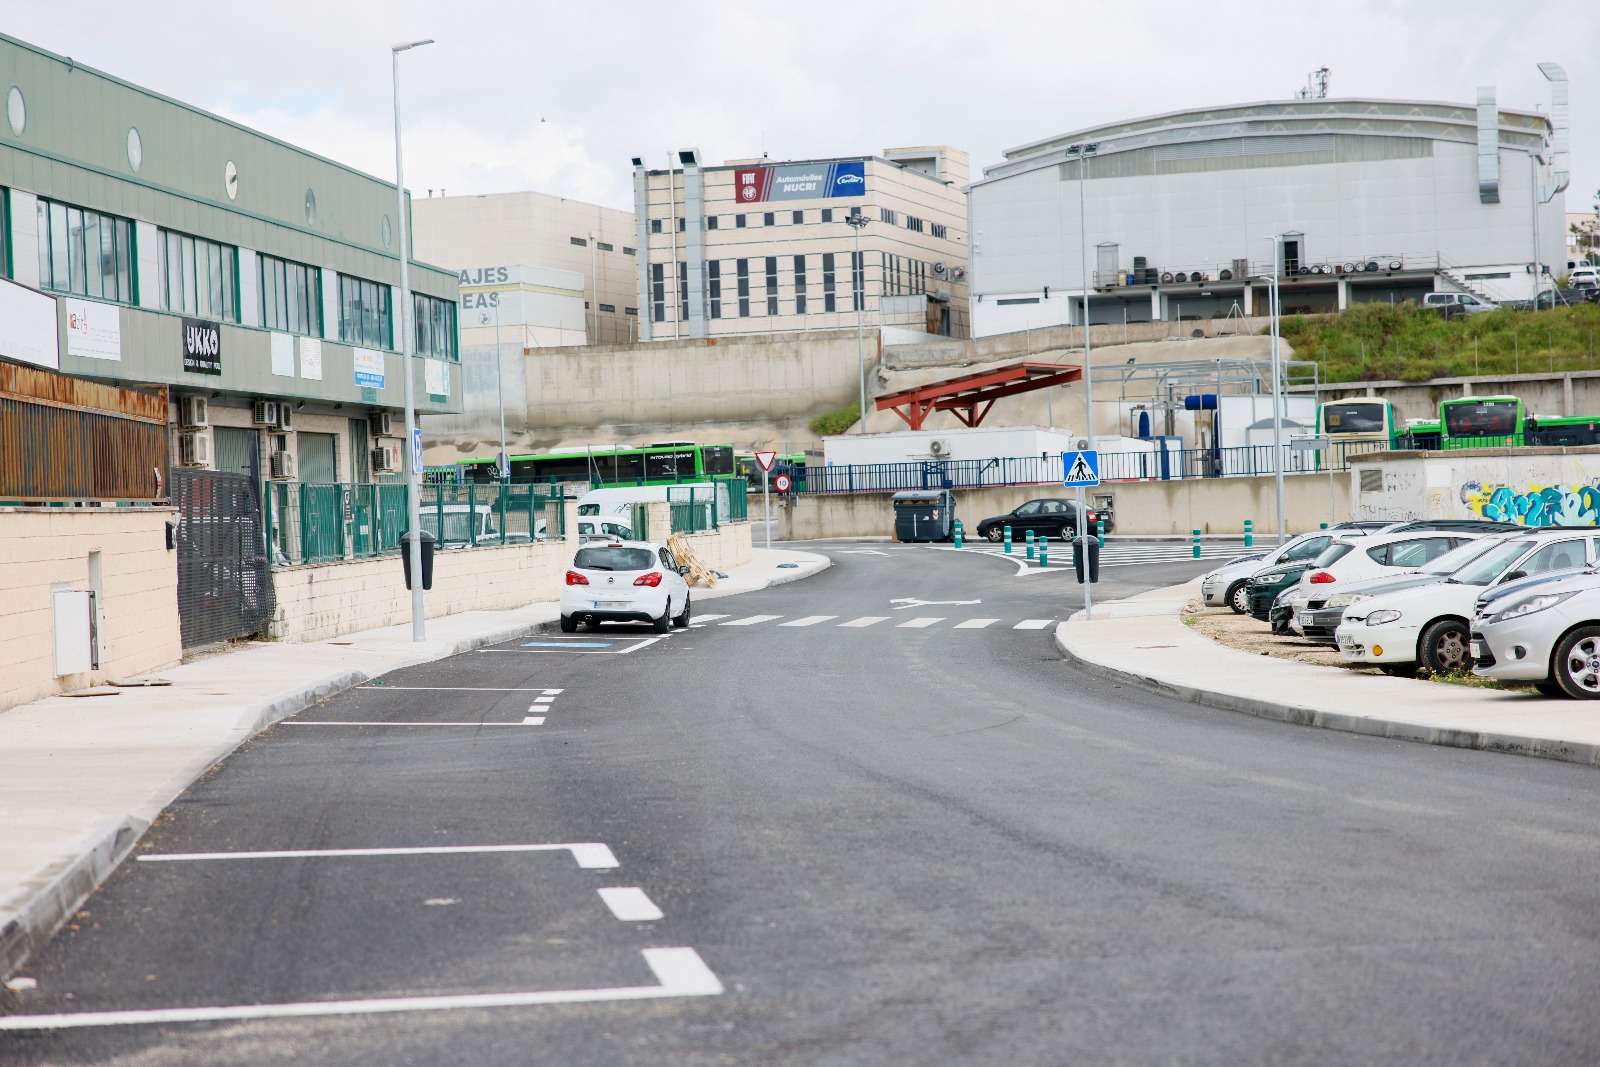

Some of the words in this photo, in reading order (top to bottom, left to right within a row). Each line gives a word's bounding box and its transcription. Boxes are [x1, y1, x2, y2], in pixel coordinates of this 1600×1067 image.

[742, 173, 756, 184] FIAT
[776, 174, 823, 184] Automóviles
[783, 182, 816, 193] NUCRI
[186, 325, 219, 357] UKKO
